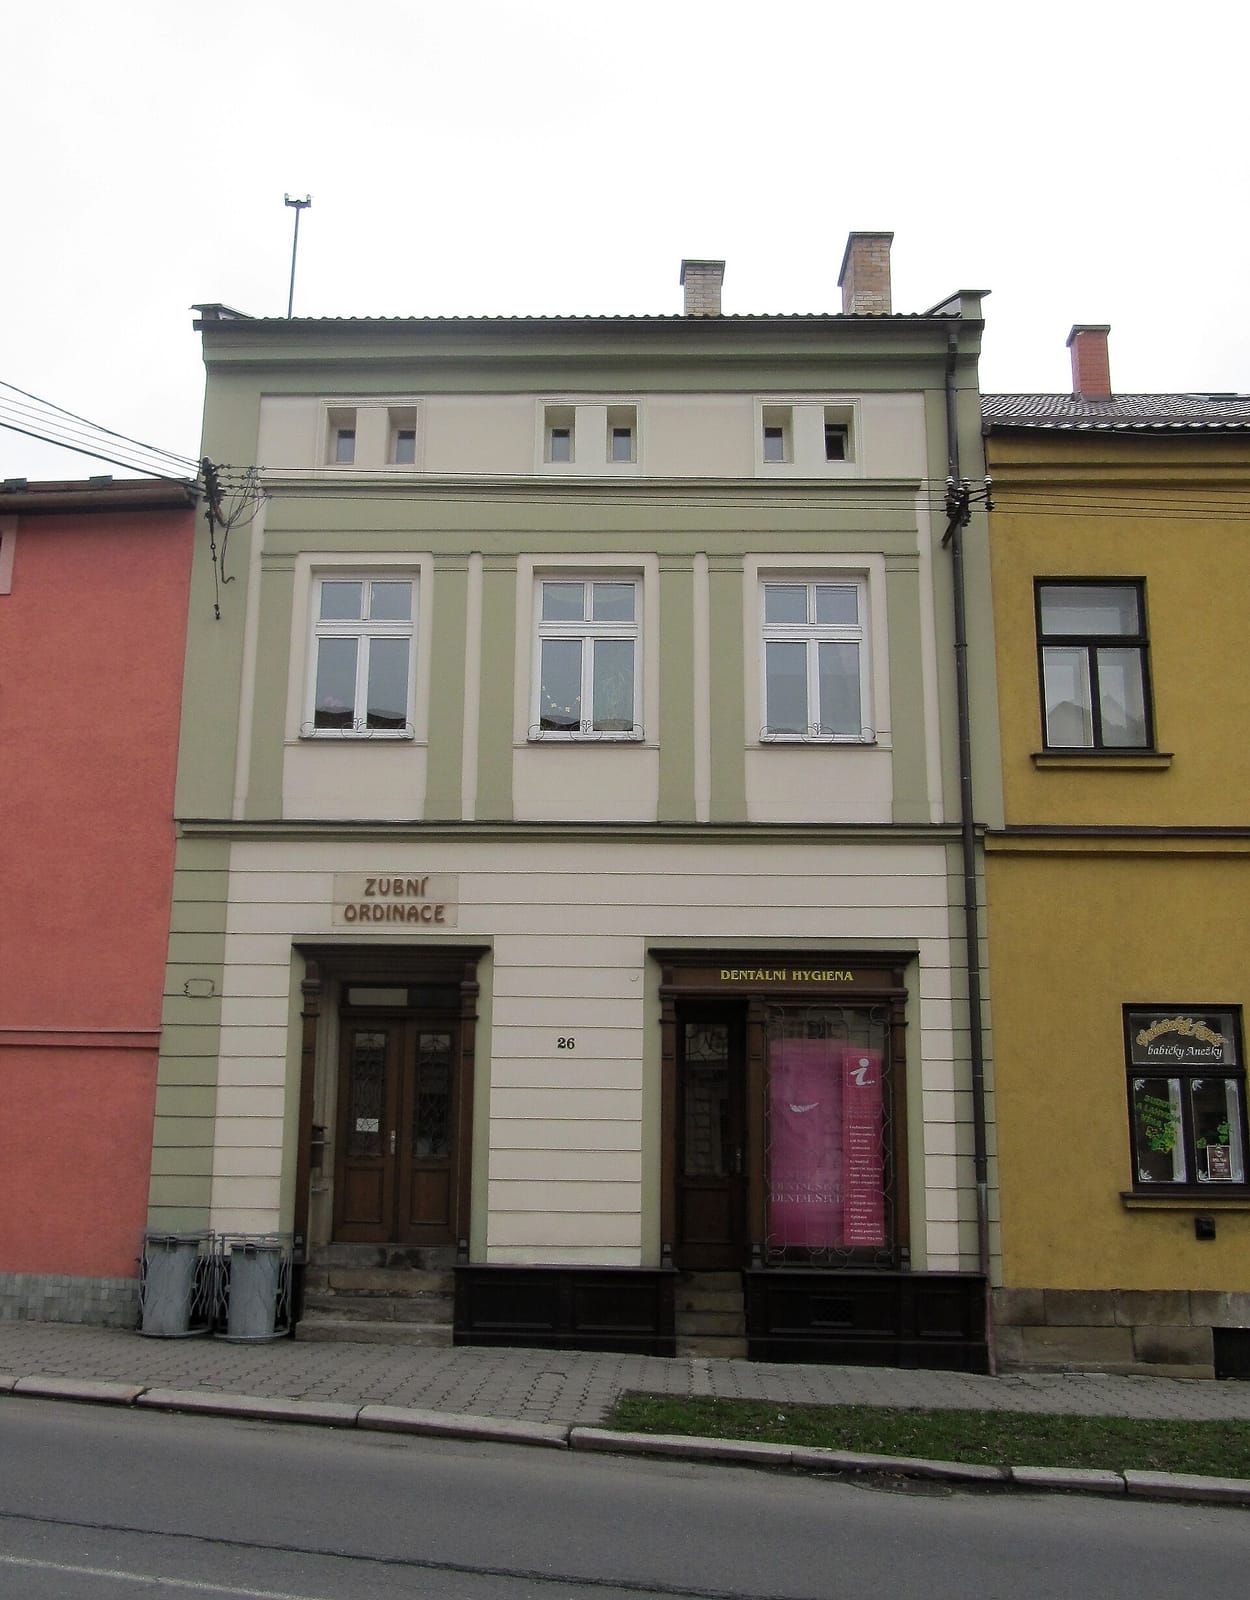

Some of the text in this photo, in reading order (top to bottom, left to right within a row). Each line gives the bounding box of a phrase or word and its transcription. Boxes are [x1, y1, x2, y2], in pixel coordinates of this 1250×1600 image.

[364, 876, 429, 897] ZUBNÍ
[344, 904, 445, 922] ORDINACE
[720, 968, 854, 981] DENTÁLNÍ HYGIENA
[557, 1037, 575, 1050] 26
[1147, 1043, 1223, 1060] babičky Anežky
